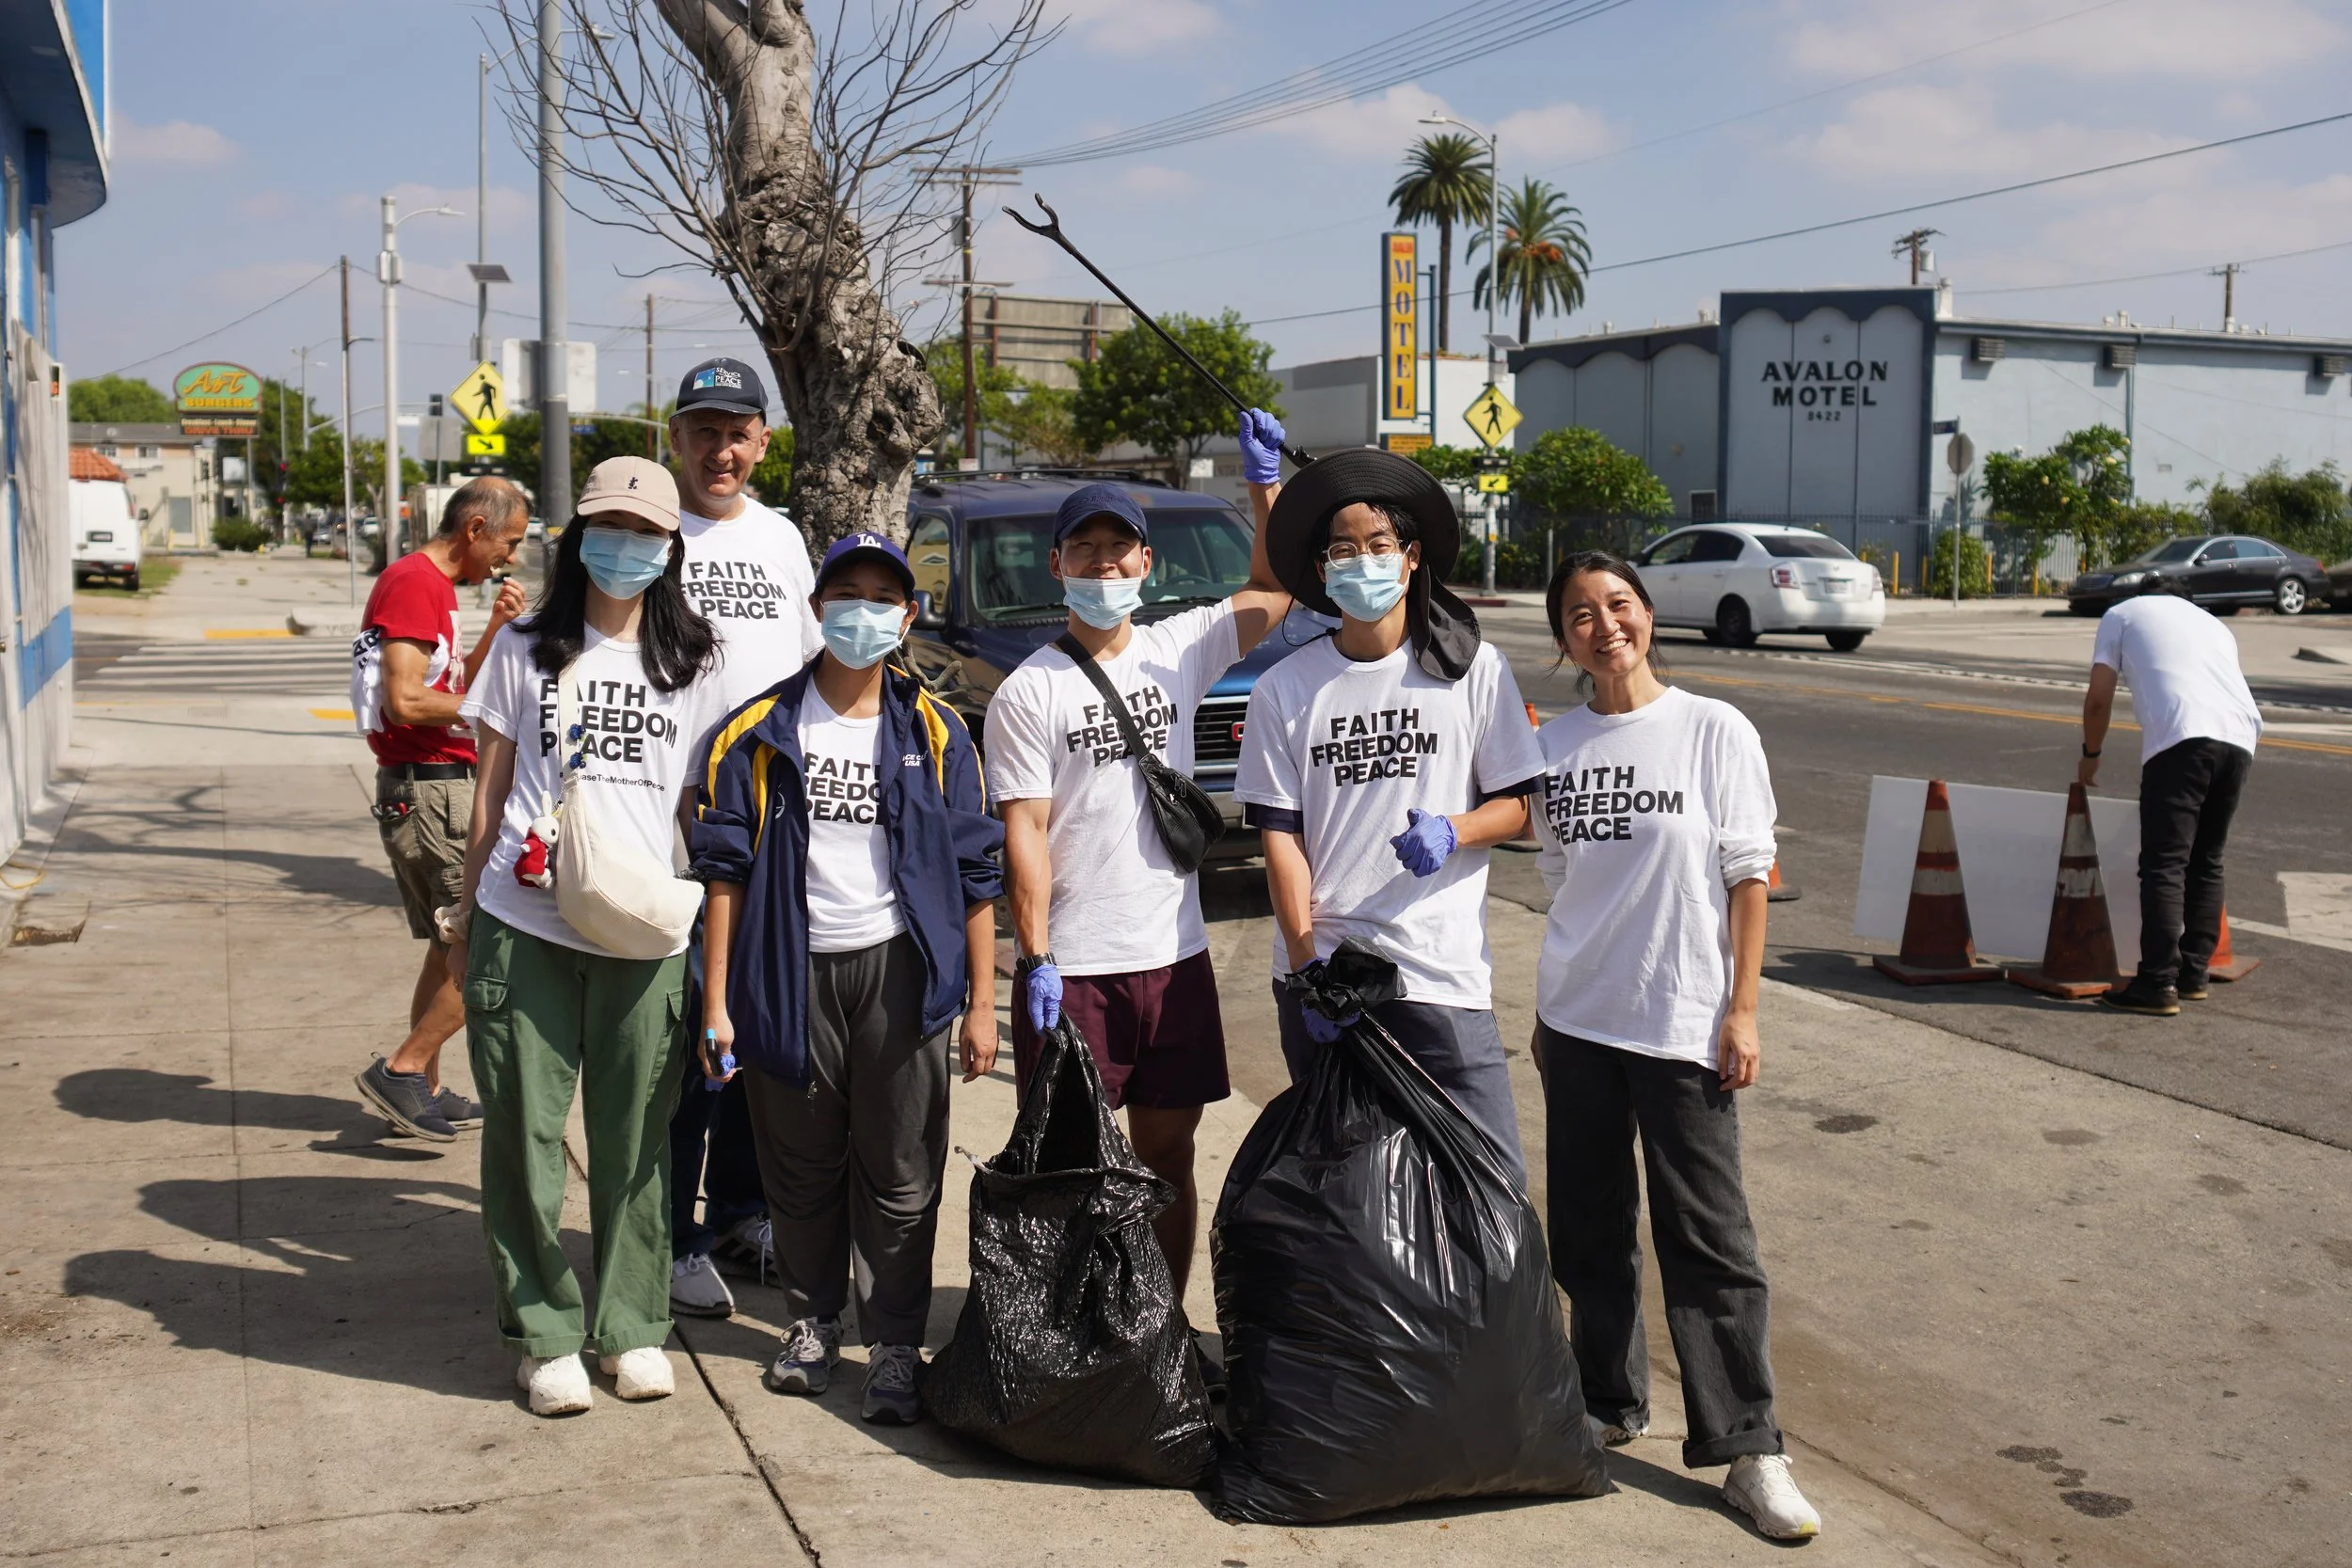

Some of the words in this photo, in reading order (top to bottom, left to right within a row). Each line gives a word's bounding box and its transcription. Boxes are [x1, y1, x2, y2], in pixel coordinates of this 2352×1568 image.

[1393, 260, 1412, 410] MOTEL
[715, 375, 742, 386] PEACE
[1760, 360, 1888, 382] AVALON
[185, 397, 253, 407] BURGERS
[1772, 386, 1878, 406] MOTEL
[688, 561, 766, 580] FAITH
[698, 599, 779, 619] PEACE
[539, 704, 677, 749] FEEDOM
[1330, 708, 1420, 739] FAITH
[540, 731, 644, 763] PACE
[1311, 732, 1438, 768] FREEDOM
[1334, 756, 1417, 786] PEACE
[1544, 766, 1635, 800] FAITH
[1546, 790, 1684, 824] FREEDOM
[1550, 816, 1632, 847] PEACE
